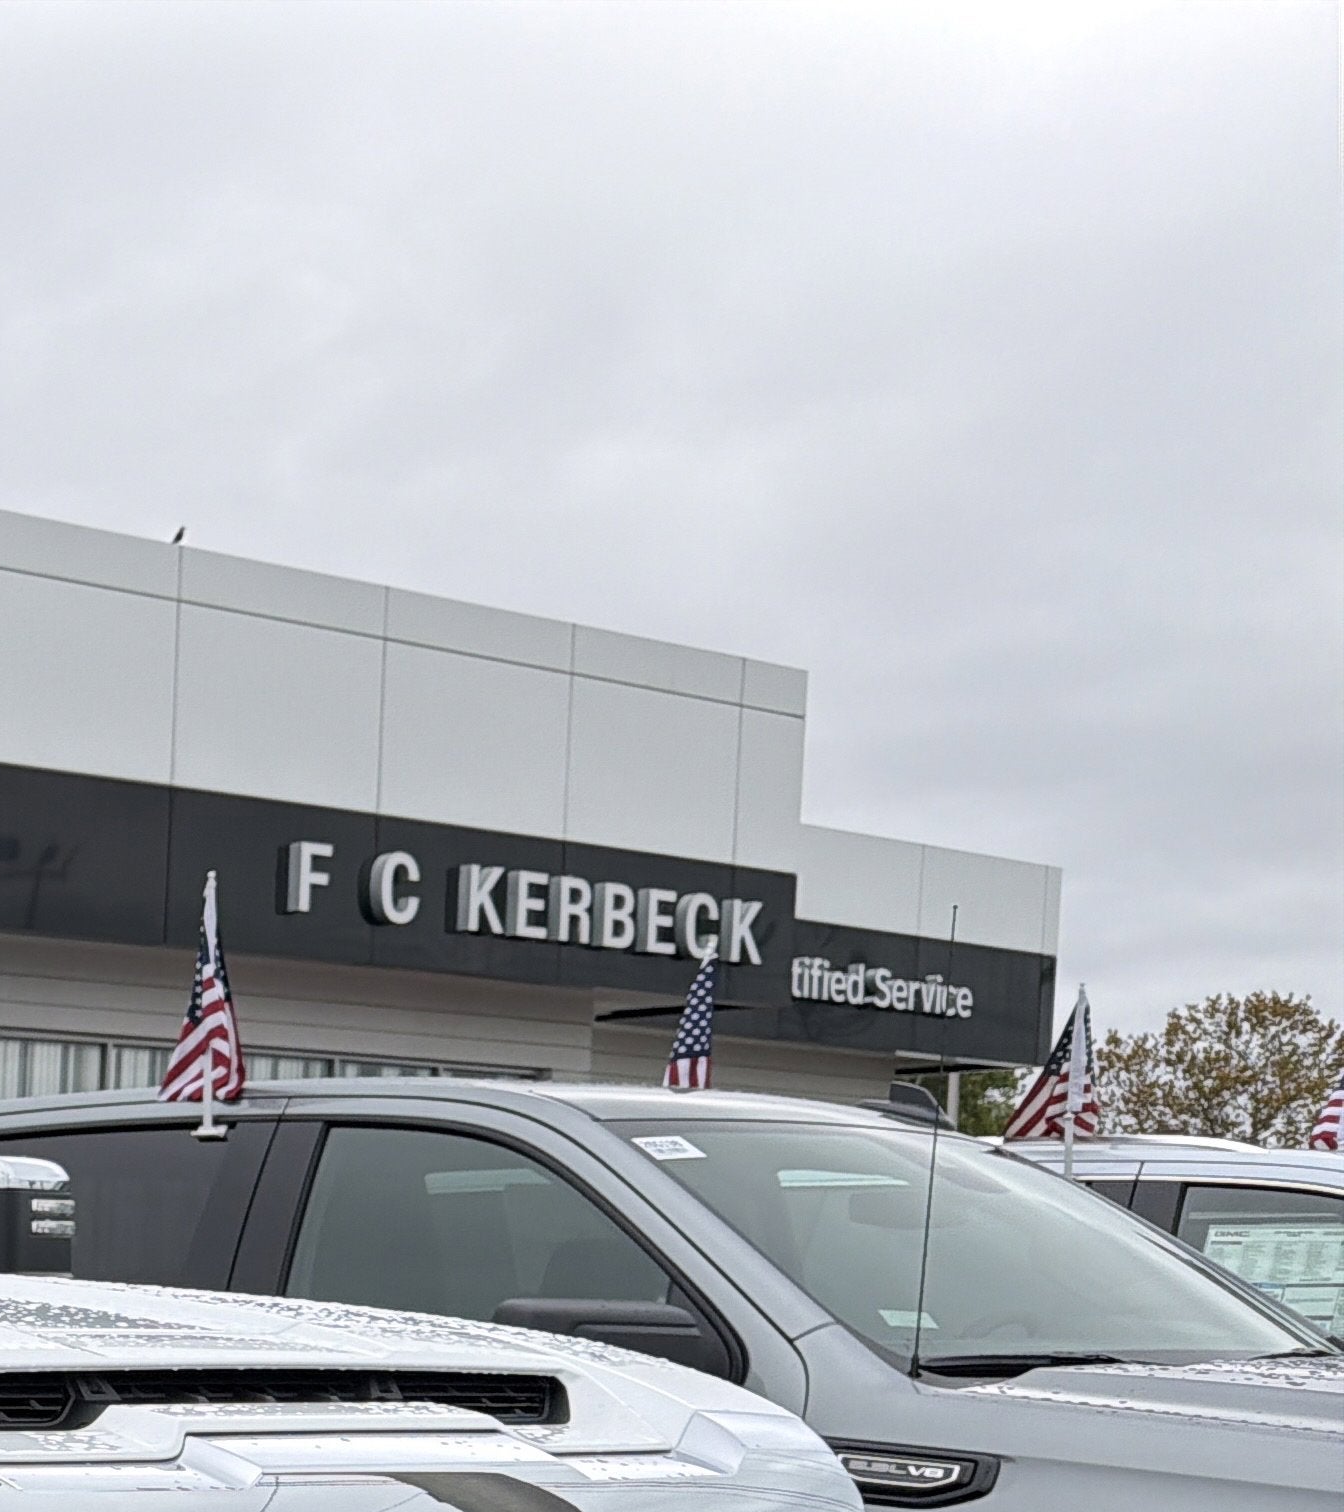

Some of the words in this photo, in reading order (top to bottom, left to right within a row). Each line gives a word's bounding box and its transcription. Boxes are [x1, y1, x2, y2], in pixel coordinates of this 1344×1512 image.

[286, 840, 334, 914] F
[367, 850, 422, 926] C
[456, 863, 763, 967] KERBECK
[907, 1465, 944, 1479] V8
